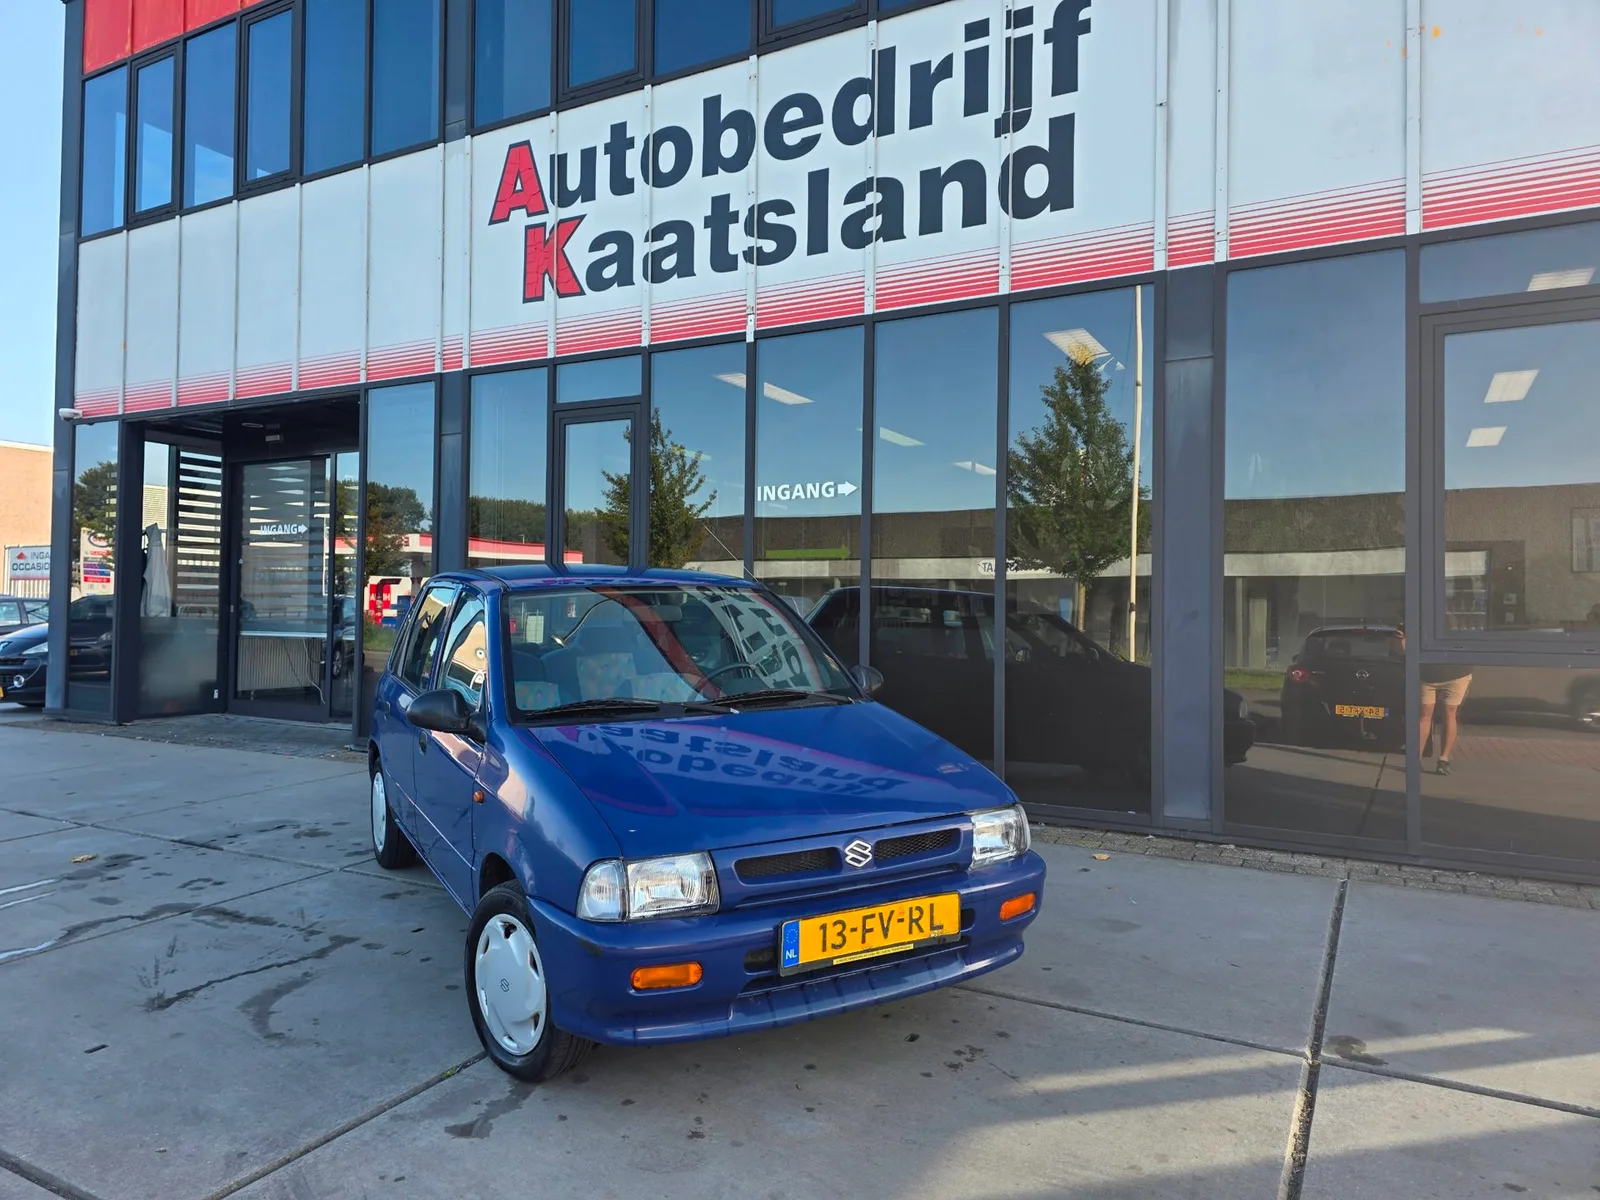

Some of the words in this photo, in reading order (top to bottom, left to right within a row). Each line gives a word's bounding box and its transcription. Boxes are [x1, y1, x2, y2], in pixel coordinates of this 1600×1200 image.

[488, 0, 1092, 225] Autobedrijf
[522, 113, 1075, 303] Kaatsland
[757, 481, 834, 502] INGANG
[260, 524, 298, 535] INGANG
[819, 902, 944, 952] 13-FV-RL
[785, 948, 798, 960] NL
